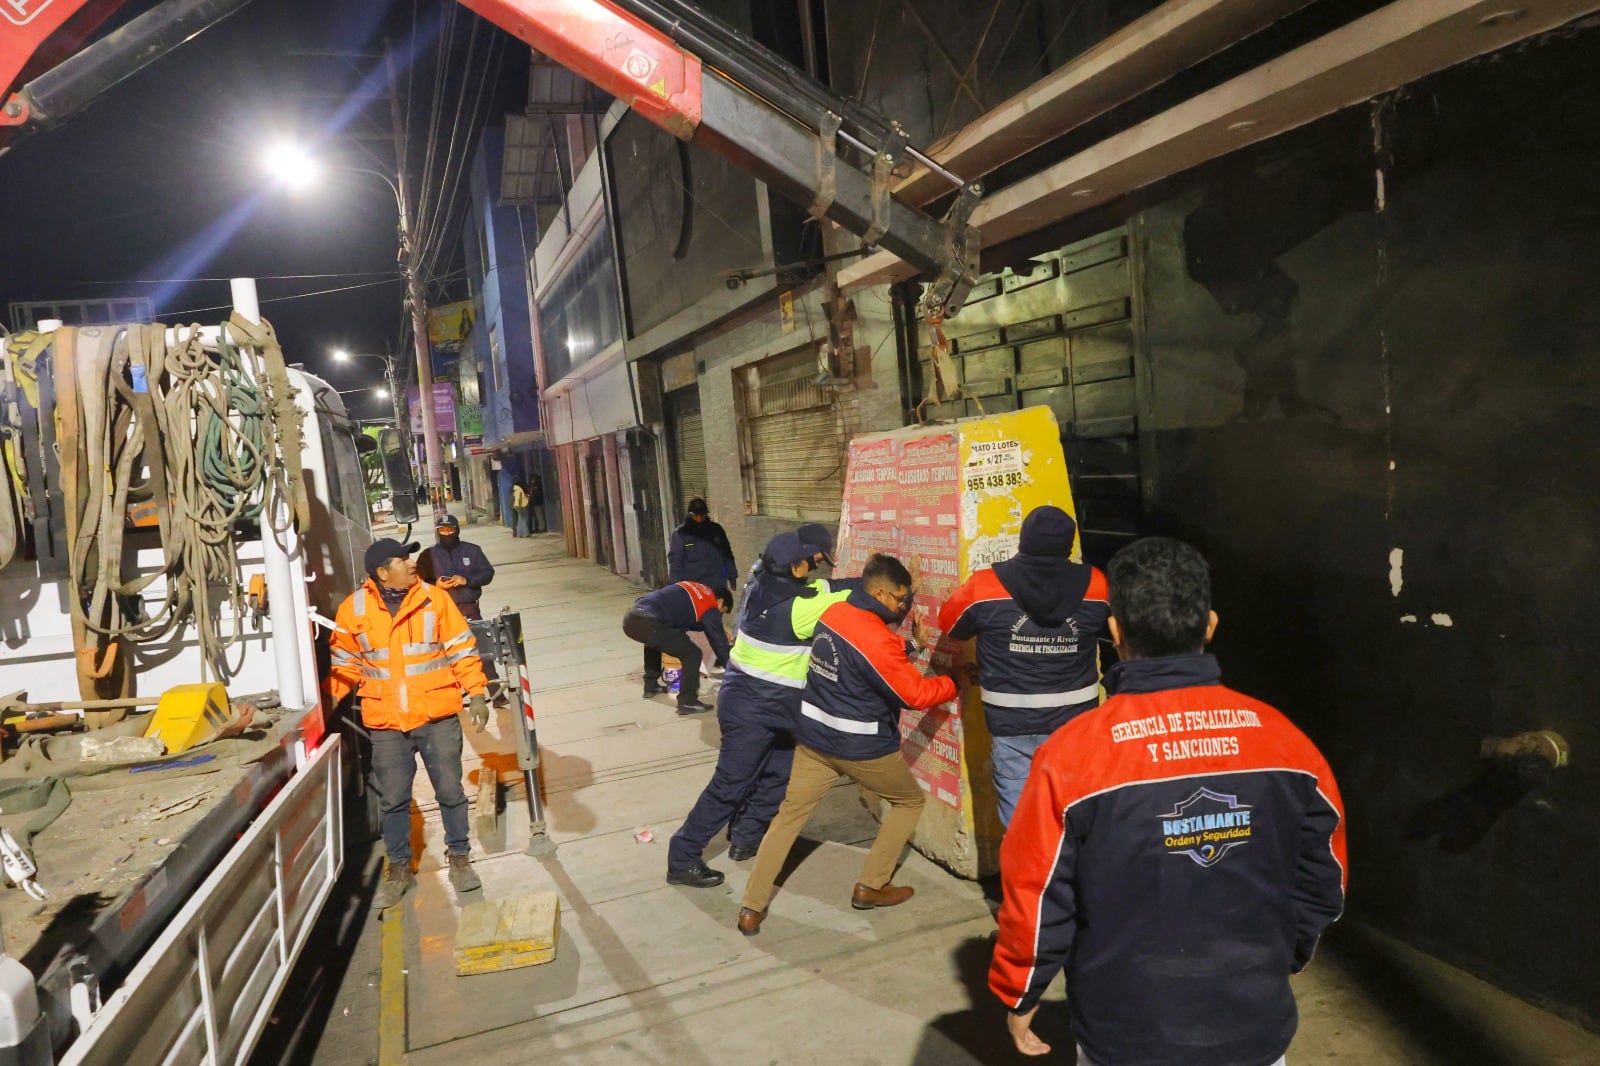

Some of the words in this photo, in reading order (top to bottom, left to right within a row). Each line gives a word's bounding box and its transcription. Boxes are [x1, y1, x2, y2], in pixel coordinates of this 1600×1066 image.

[967, 477, 985, 491] 955
[986, 474, 1004, 488] 438
[1005, 472, 1022, 486] 383
[1011, 633, 1050, 643] Bustamante
[1111, 715, 1168, 743] GERENCIA
[1167, 712, 1184, 733] DE
[932, 738, 959, 764] TEMPORAL
[1147, 743, 1158, 762] Y
[1162, 736, 1240, 760] SANCIONES
[1162, 810, 1251, 836] BUSTAMANTE
[1165, 835, 1195, 847] Orden
[1195, 835, 1202, 845] y
[1203, 827, 1251, 841] Seguridad
